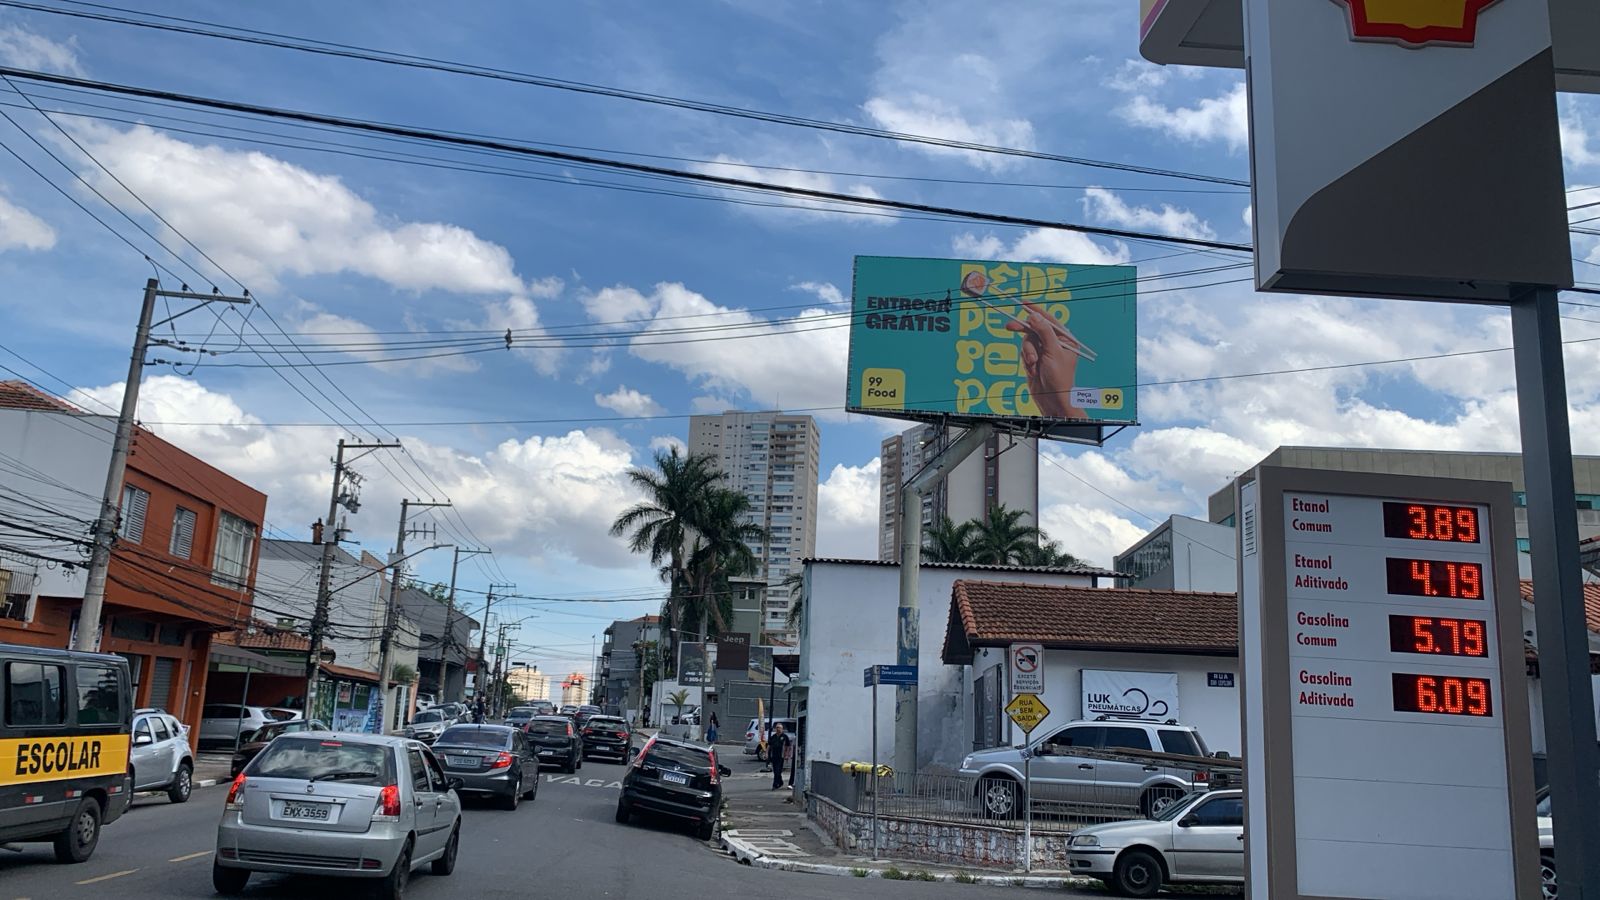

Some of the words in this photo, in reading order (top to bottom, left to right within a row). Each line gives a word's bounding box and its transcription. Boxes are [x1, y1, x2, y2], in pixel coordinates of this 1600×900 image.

[866, 311, 951, 332] GRÁTIS
[868, 376, 883, 387] 99
[868, 388, 896, 398] Food
[1076, 391, 1092, 399] Peça
[1104, 394, 1120, 405] 99
[1292, 498, 1329, 513] Etanol
[1292, 518, 1332, 533] Comum
[1408, 506, 1476, 542] 3.89
[1294, 554, 1332, 569] Etanol
[1294, 575, 1348, 591] Aditivado
[1412, 561, 1480, 598] 4.19
[1297, 611, 1349, 628] Gasolina
[723, 635, 745, 643] Jeep
[1297, 632, 1337, 647] Comum
[1414, 618, 1483, 655] 5.79
[1299, 670, 1352, 686] Gasolina
[1088, 693, 1111, 703] LUK
[1299, 691, 1354, 707] Aditivada
[1417, 677, 1487, 714] 6.09
[1088, 703, 1141, 712] PNEUMÁTICAS
[16, 741, 101, 775] ESCOLAR
